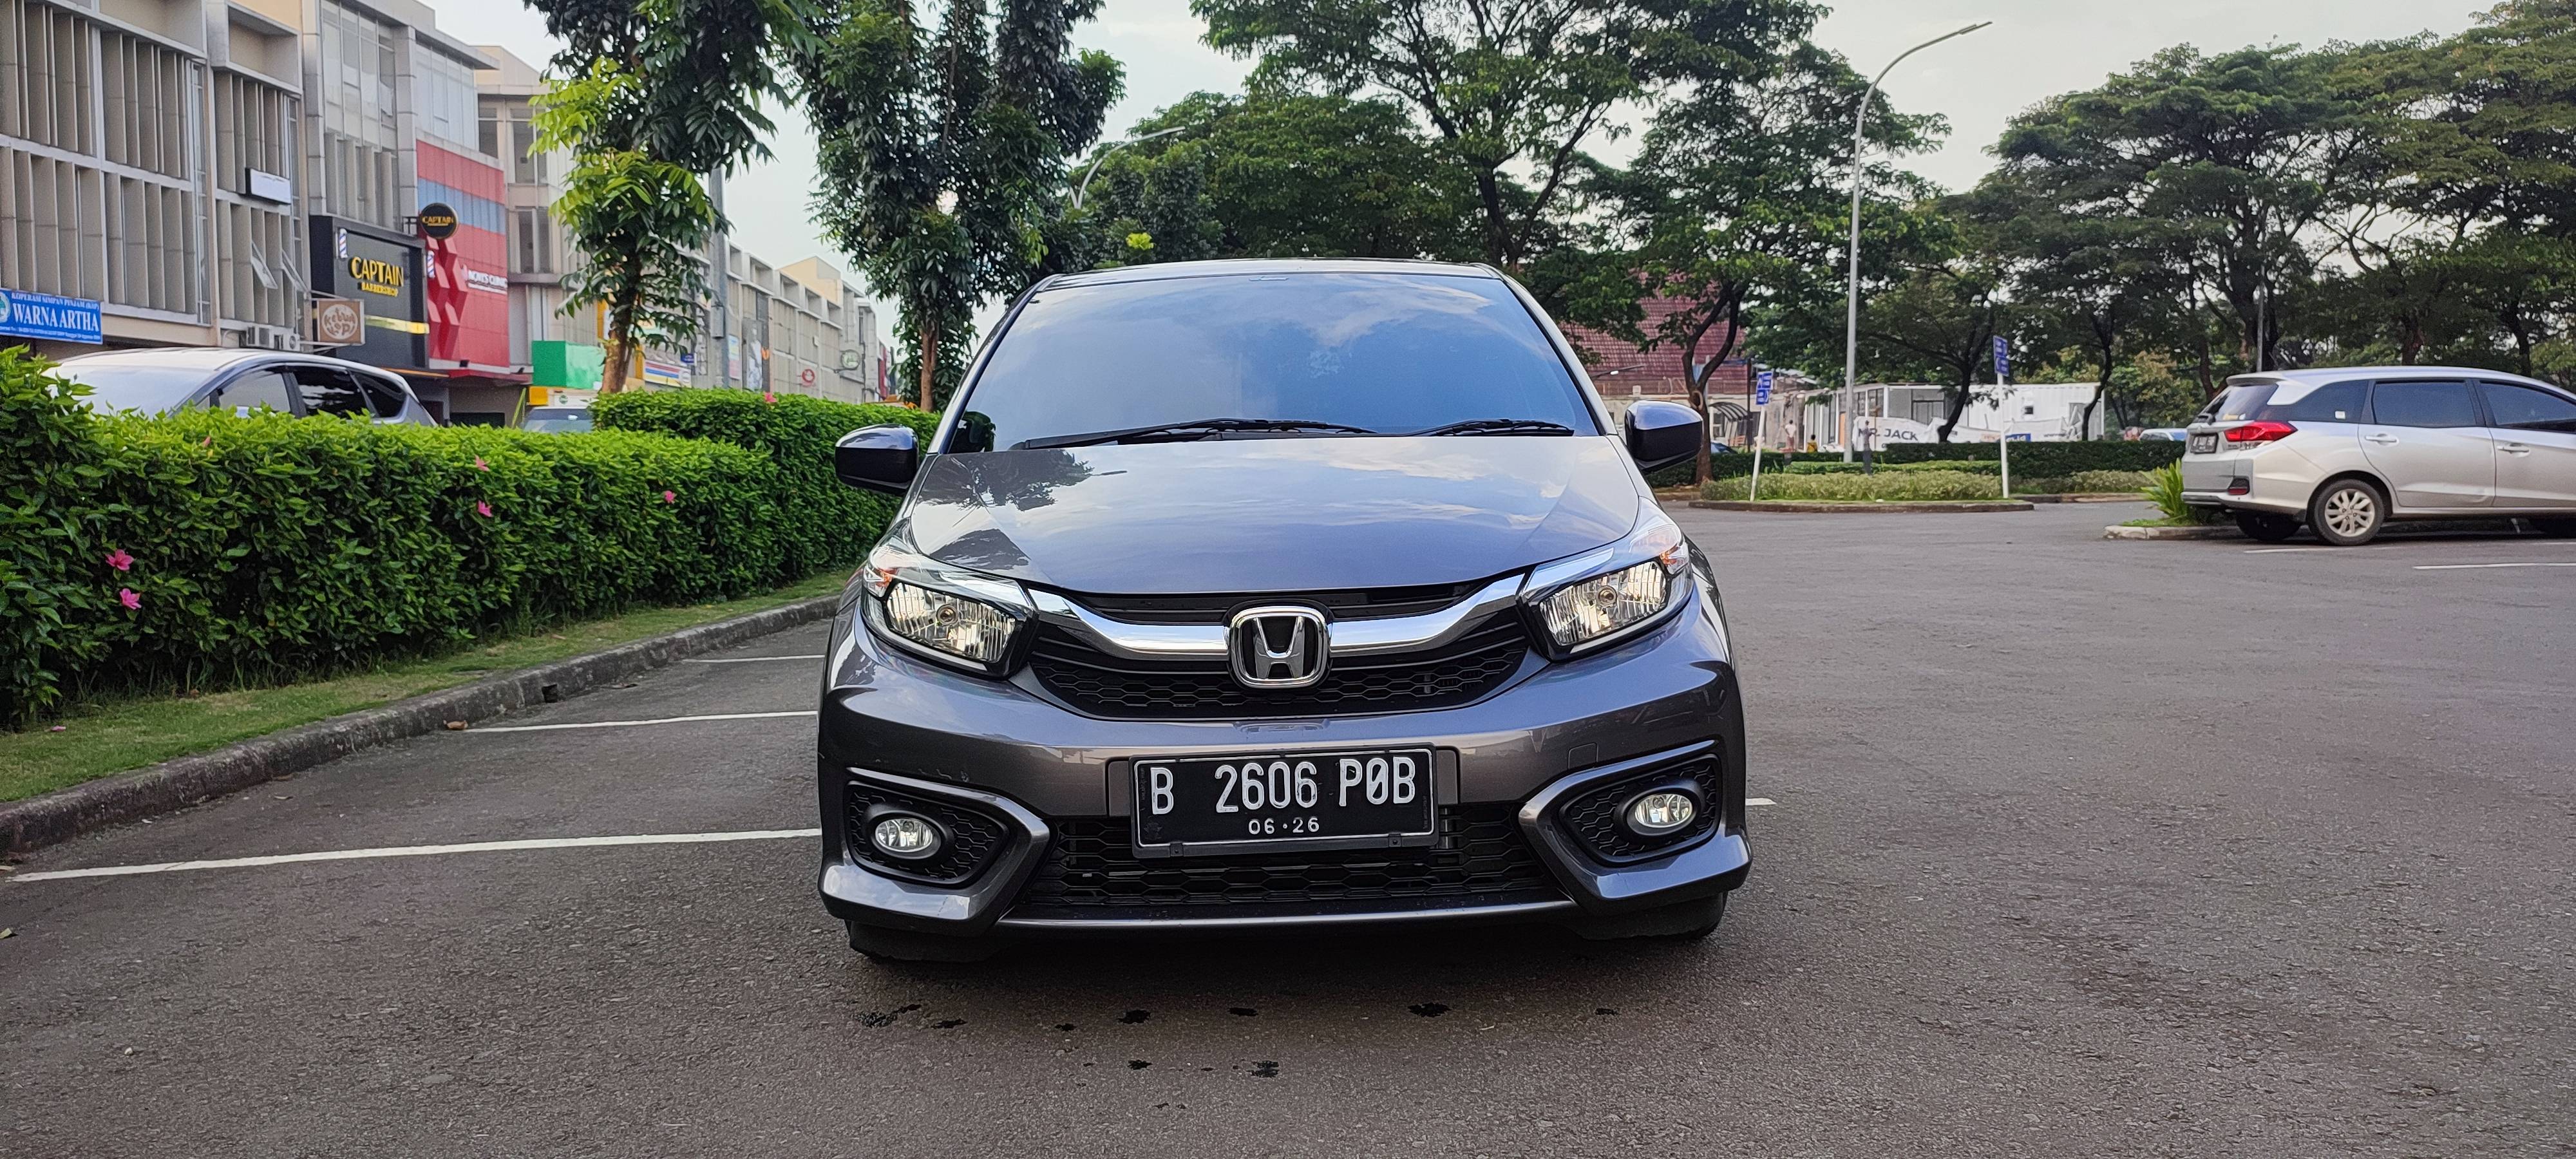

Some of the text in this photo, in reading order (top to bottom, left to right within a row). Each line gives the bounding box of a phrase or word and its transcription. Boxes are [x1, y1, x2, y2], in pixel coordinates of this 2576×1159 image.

[422, 216, 454, 224] CAPTAIN
[351, 256, 404, 287] CAPTAIN
[12, 303, 99, 332] WARNA ARTHA
[1884, 428, 1918, 441] JACK
[1150, 767, 1174, 815] B
[1215, 761, 1318, 813] 2606
